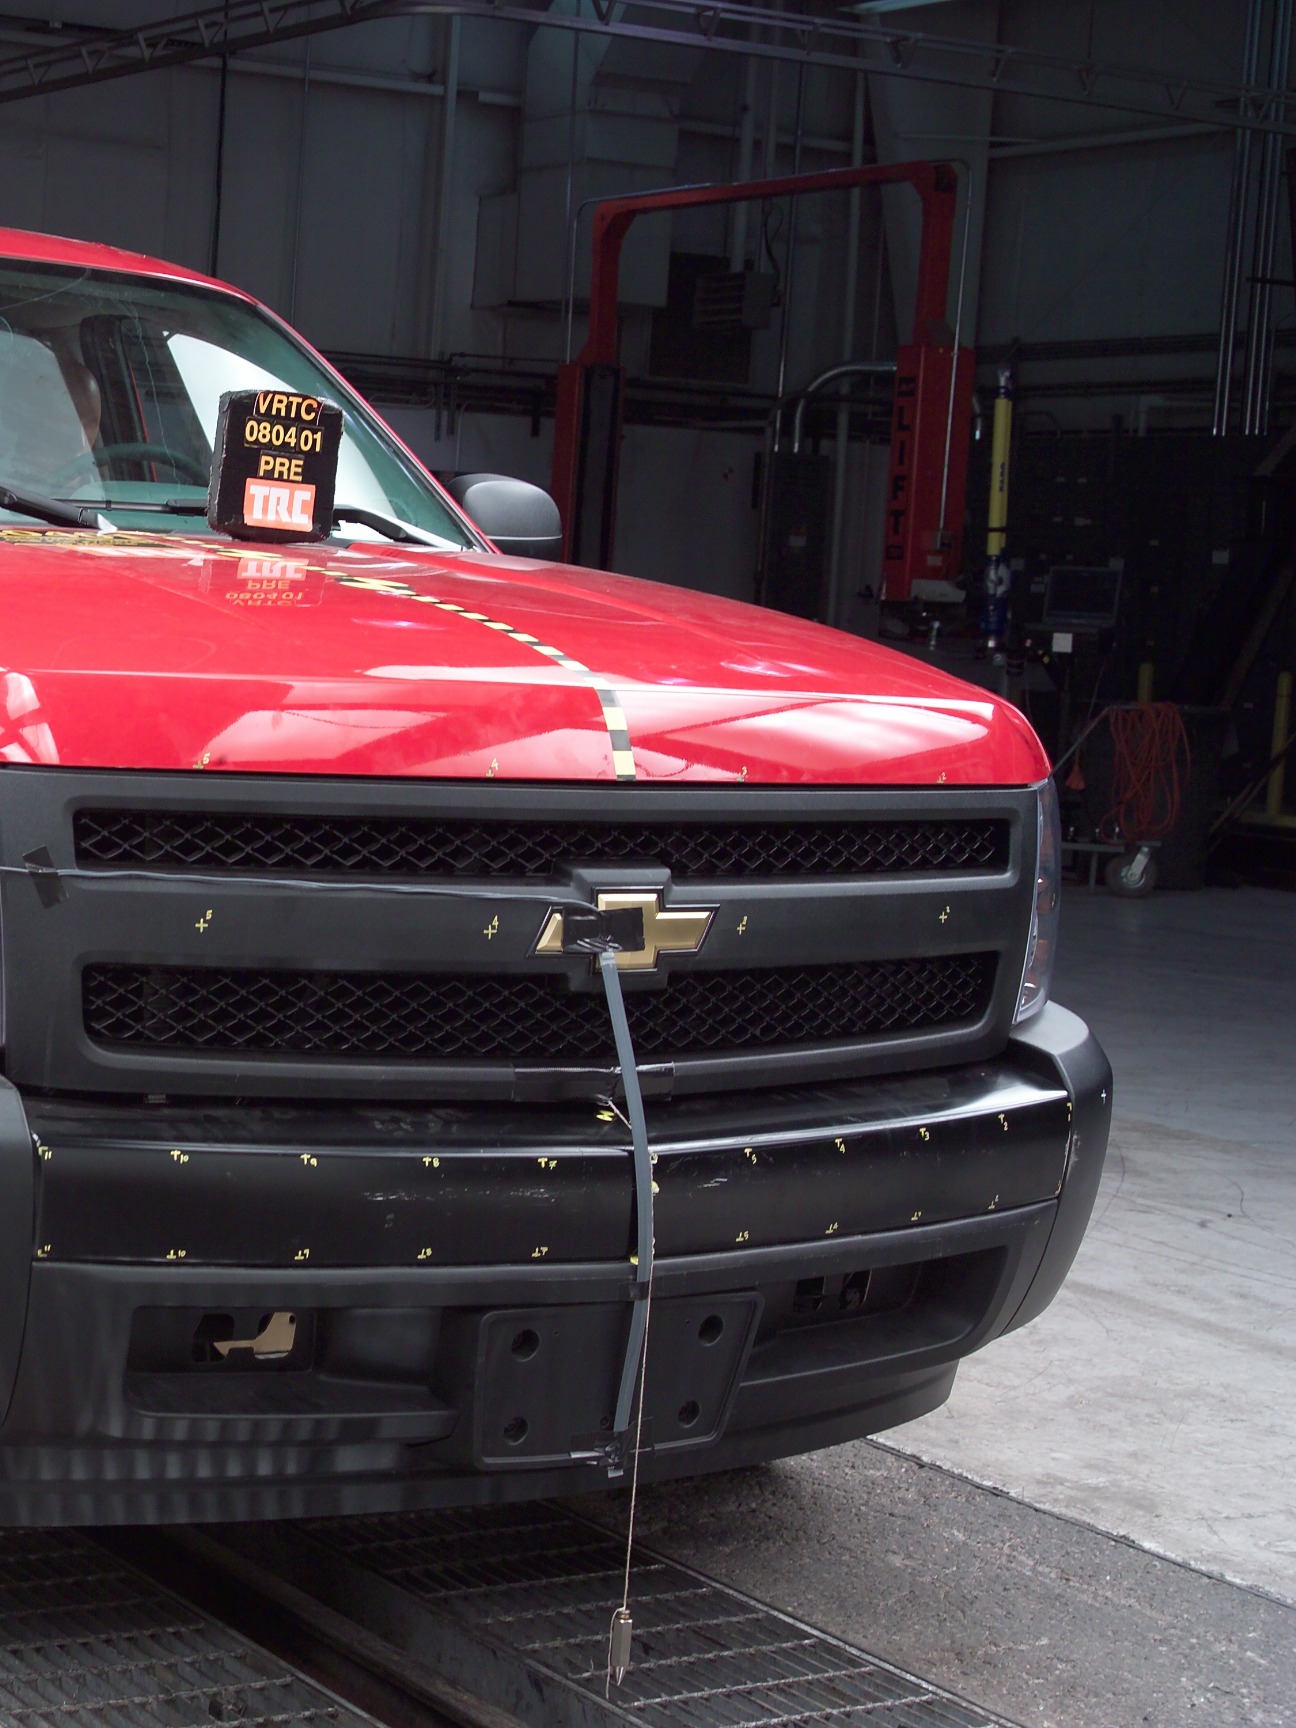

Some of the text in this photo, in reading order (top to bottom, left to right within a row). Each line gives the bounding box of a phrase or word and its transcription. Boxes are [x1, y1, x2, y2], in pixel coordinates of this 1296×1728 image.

[258, 393, 318, 421] VRTC
[245, 420, 322, 452] 080401
[258, 455, 304, 481] PRE
[891, 406, 910, 534] LIFT
[249, 484, 311, 524] TRC
